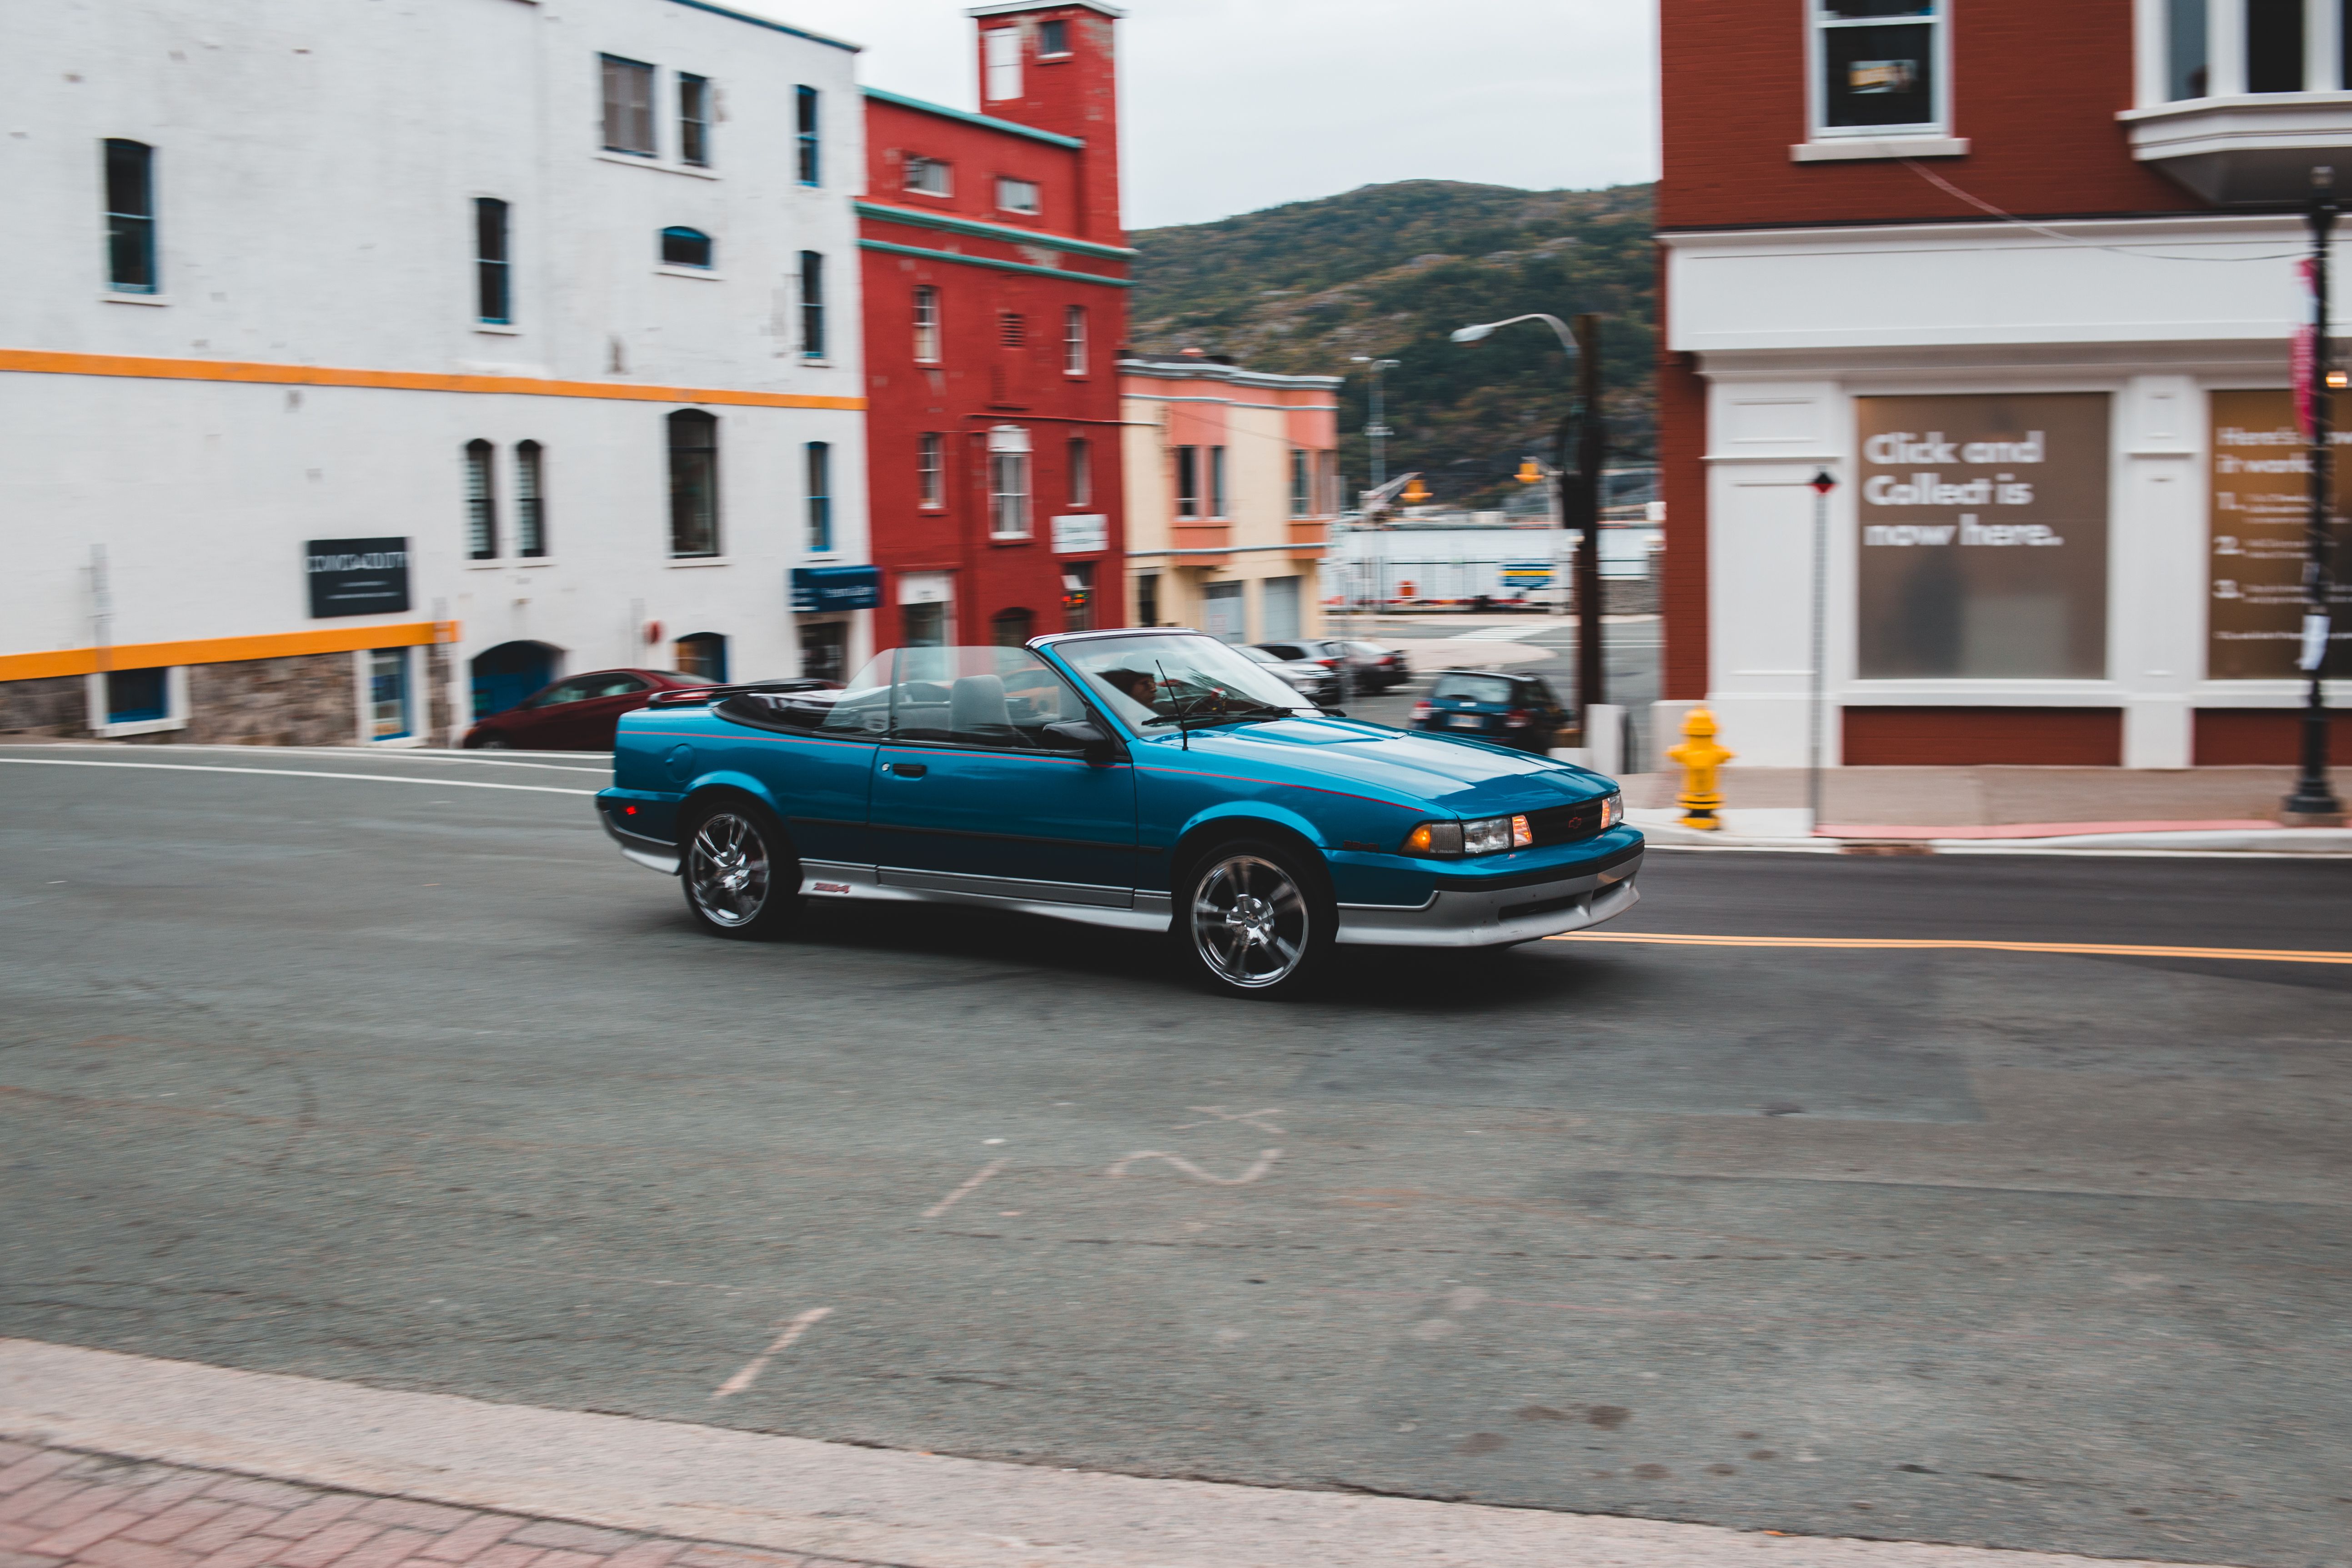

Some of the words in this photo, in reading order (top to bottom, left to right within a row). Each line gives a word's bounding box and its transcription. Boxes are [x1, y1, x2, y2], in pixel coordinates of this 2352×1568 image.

[1865, 431, 1959, 464] Click
[1961, 430, 2046, 463] and
[1865, 472, 1992, 505] Collect
[1995, 473, 2034, 505] is
[1864, 525, 1956, 546] now
[1958, 513, 2065, 546] here.
